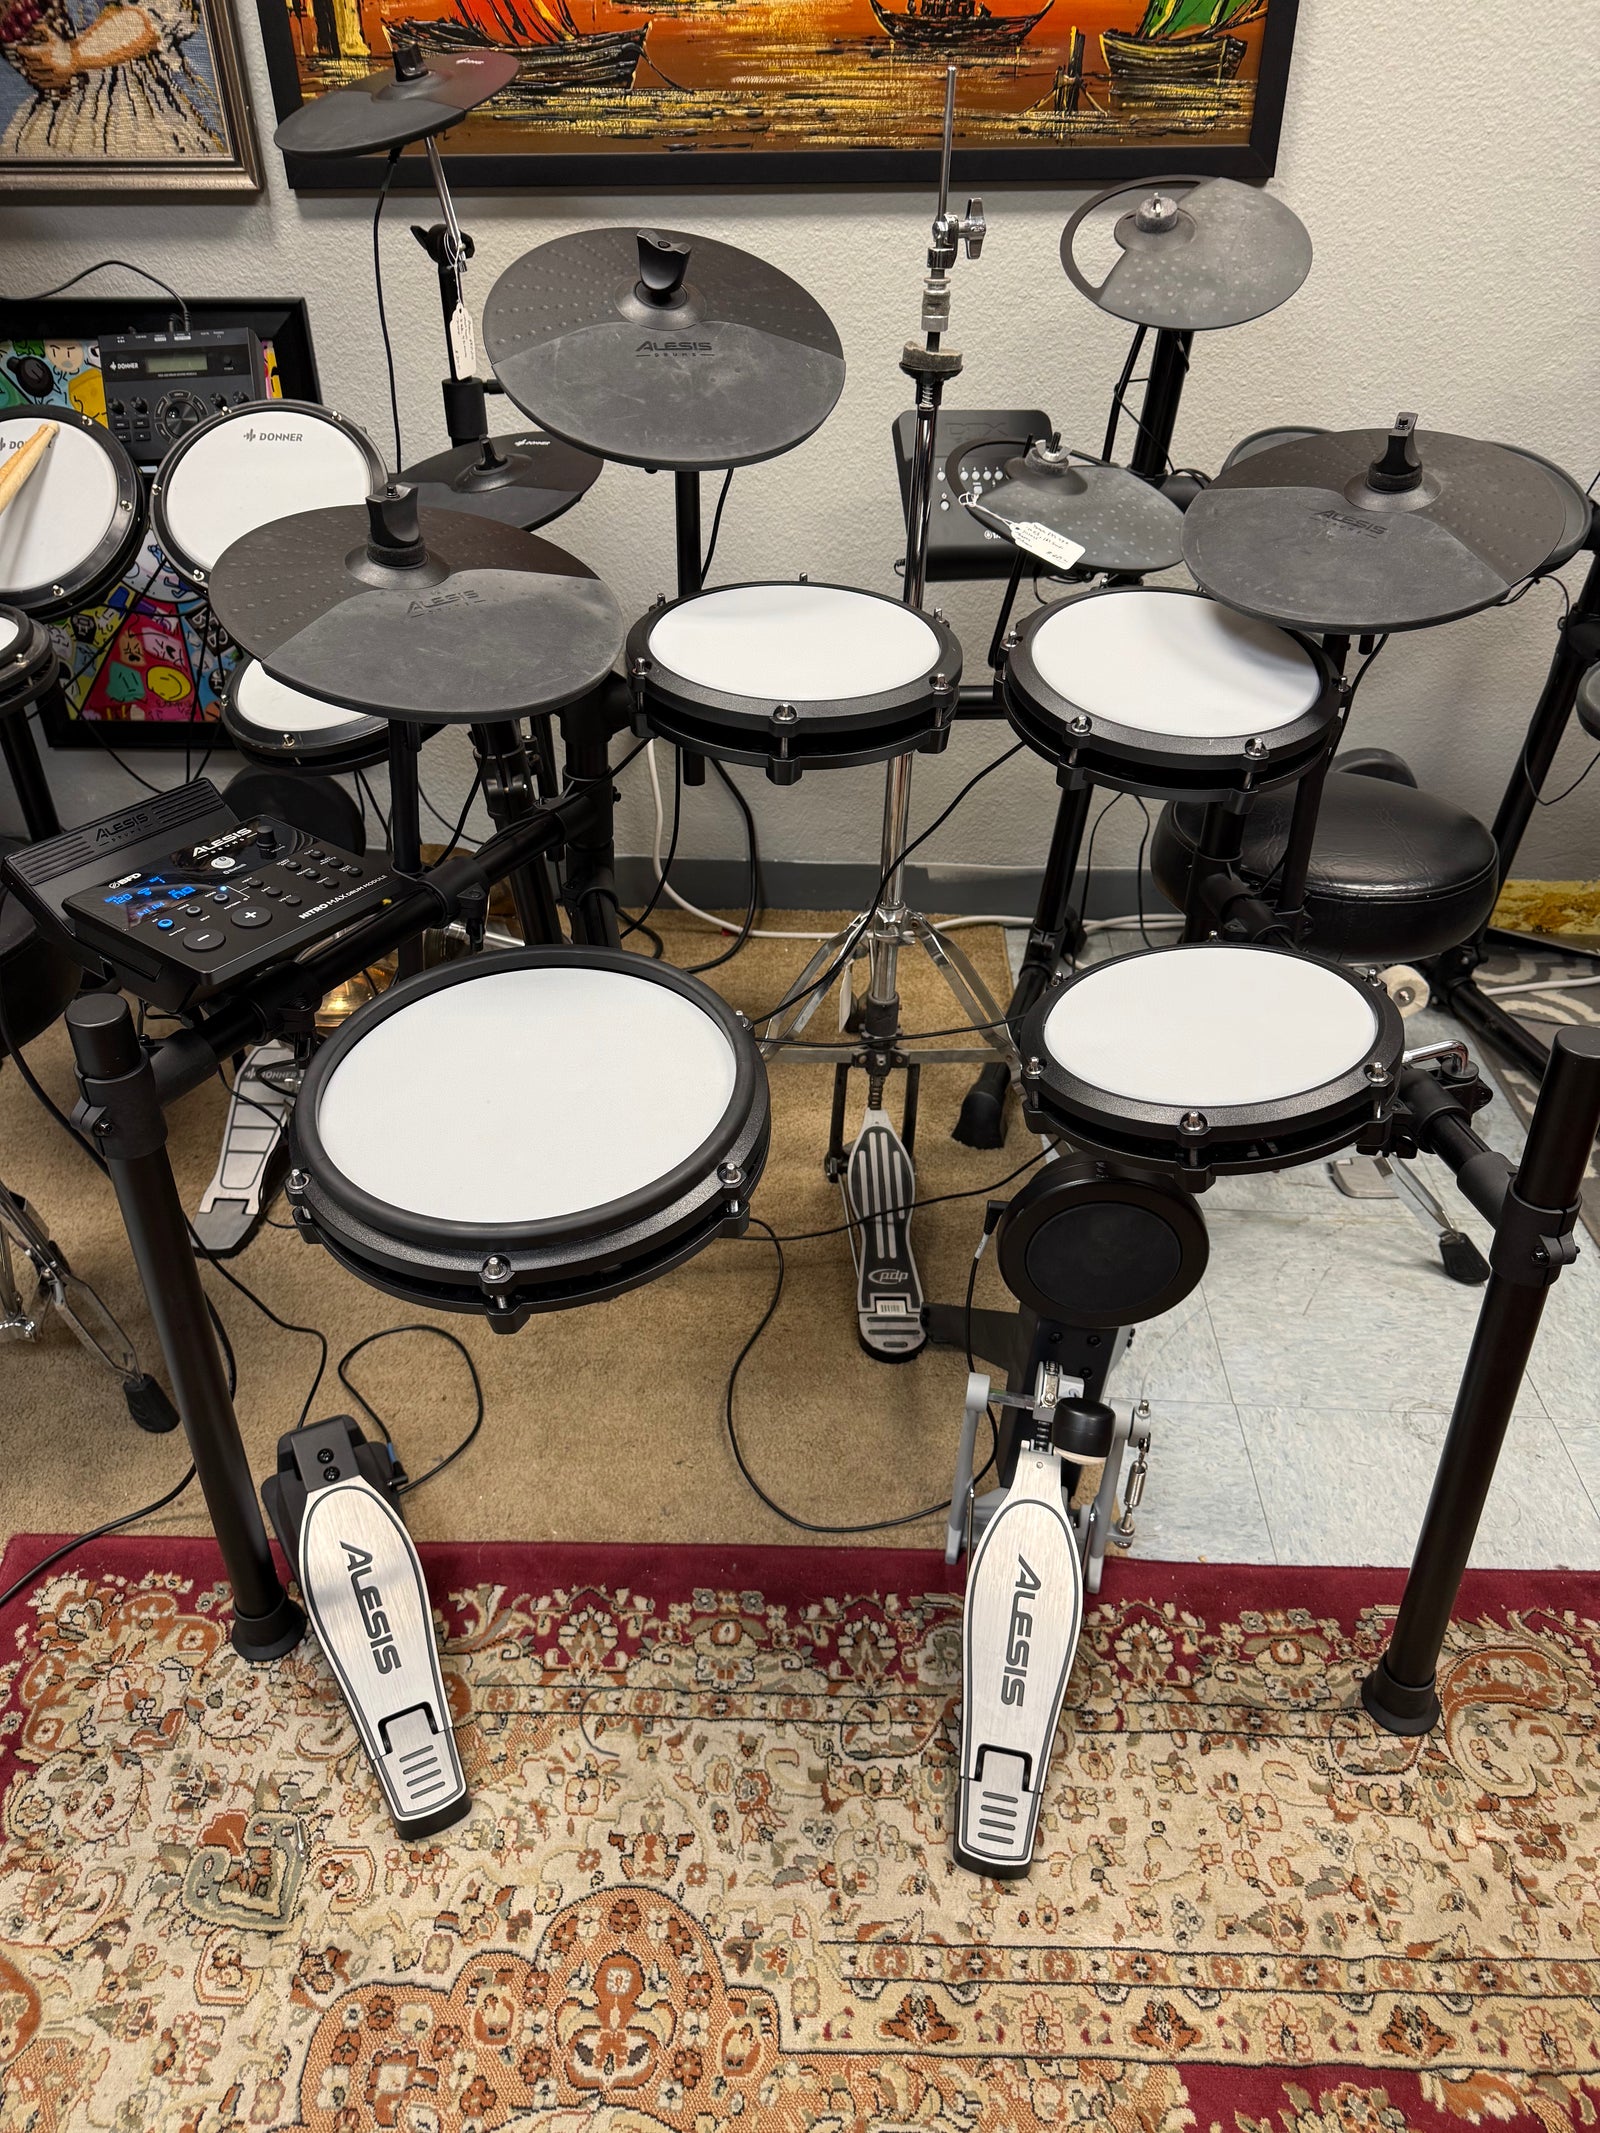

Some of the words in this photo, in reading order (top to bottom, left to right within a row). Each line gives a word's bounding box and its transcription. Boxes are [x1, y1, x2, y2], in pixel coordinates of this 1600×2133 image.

[635, 341, 712, 352] ALESIS
[259, 432, 303, 441] DONNER
[1313, 510, 1388, 534] ALESIS
[407, 590, 479, 614] ALESIS
[95, 813, 148, 842] ALESIS
[192, 827, 252, 857] ALESIS
[117, 872, 142, 885] BFD
[298, 903, 328, 919] NITRO
[326, 893, 347, 906] MAX
[880, 1270, 908, 1283] pdp
[339, 1540, 402, 1675] ALESIS
[1001, 1553, 1042, 1707] ALESIS
